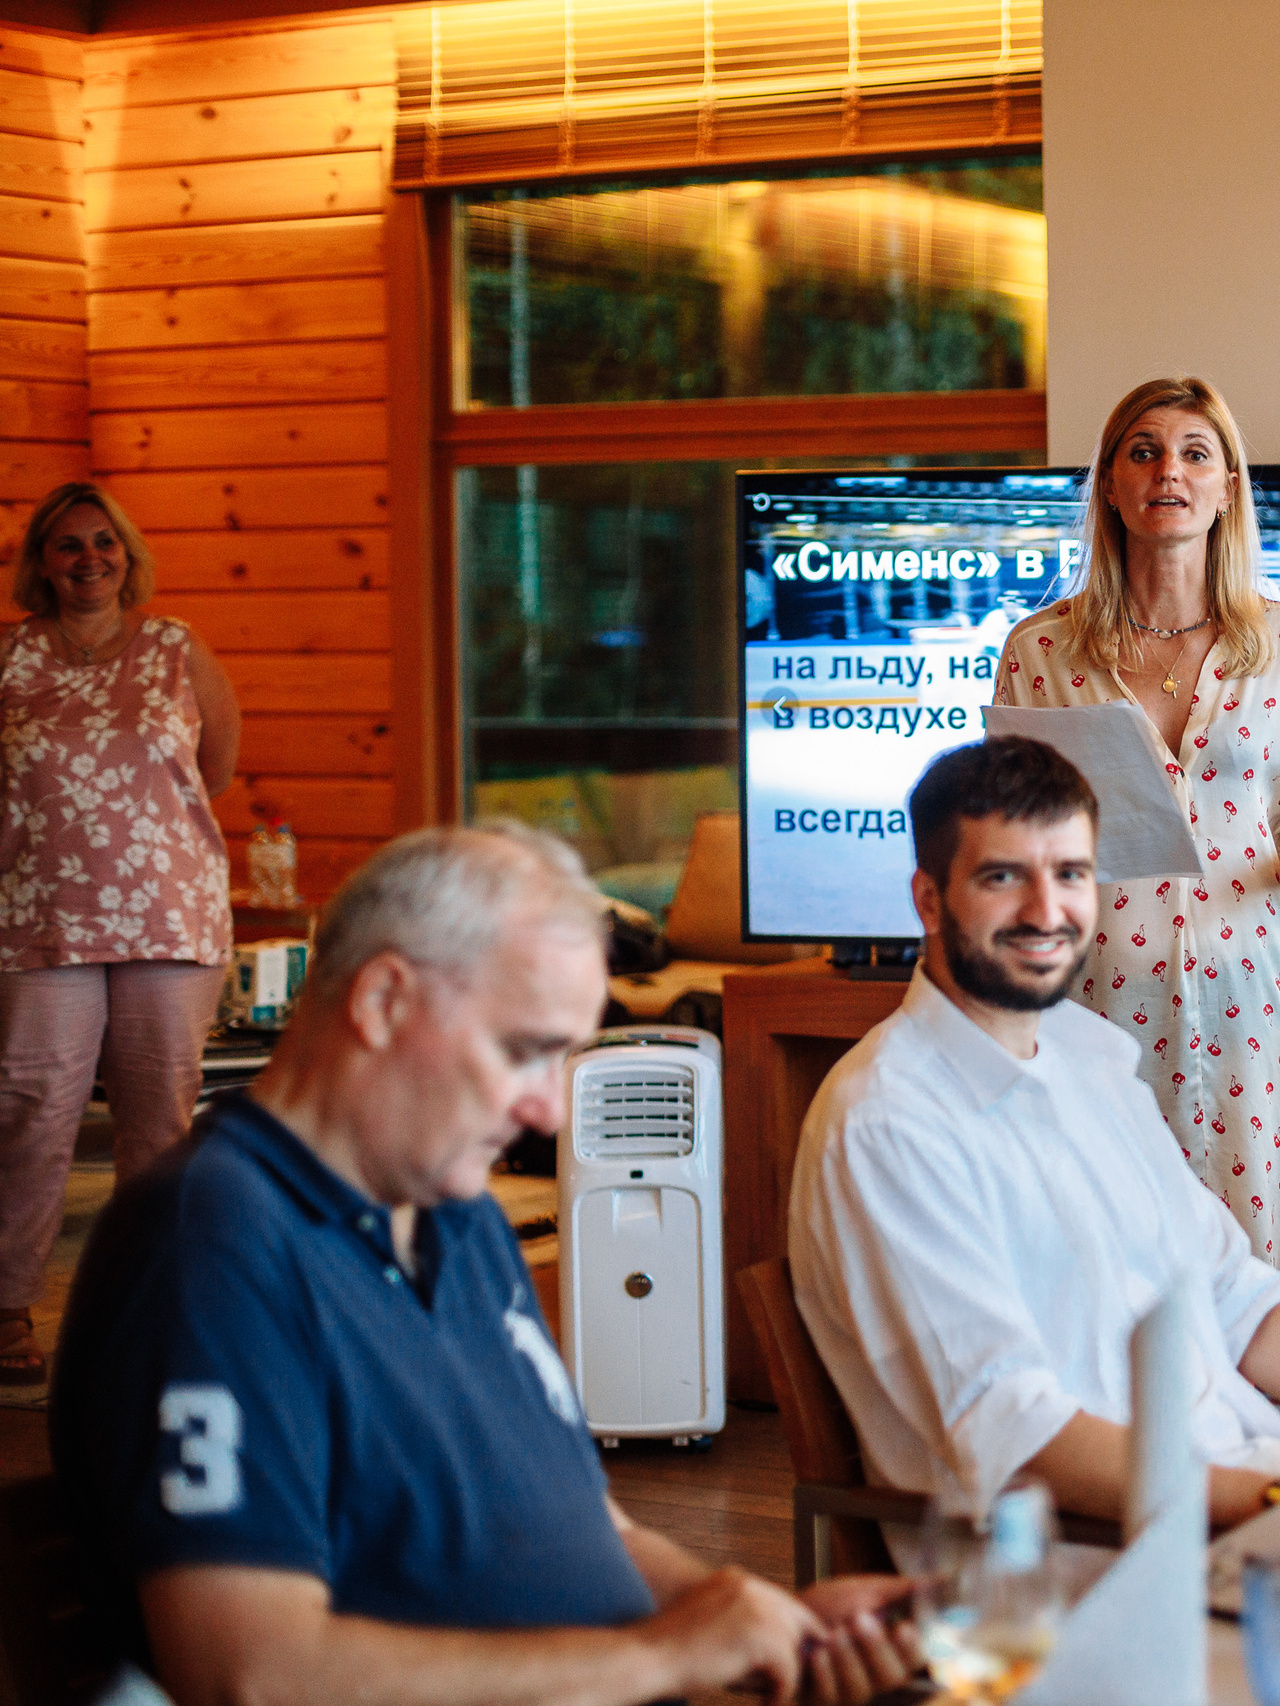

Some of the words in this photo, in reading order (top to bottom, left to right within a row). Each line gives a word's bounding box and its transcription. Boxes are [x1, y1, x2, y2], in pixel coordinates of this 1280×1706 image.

[772, 541, 1001, 583] «Сименс»
[1016, 549, 1045, 580] в
[773, 656, 816, 680] на
[828, 656, 933, 688] льду,
[949, 656, 993, 680] на
[774, 706, 795, 730] в
[809, 706, 968, 738] воздухе
[774, 808, 908, 839] всегда
[159, 1385, 243, 1515] 3
